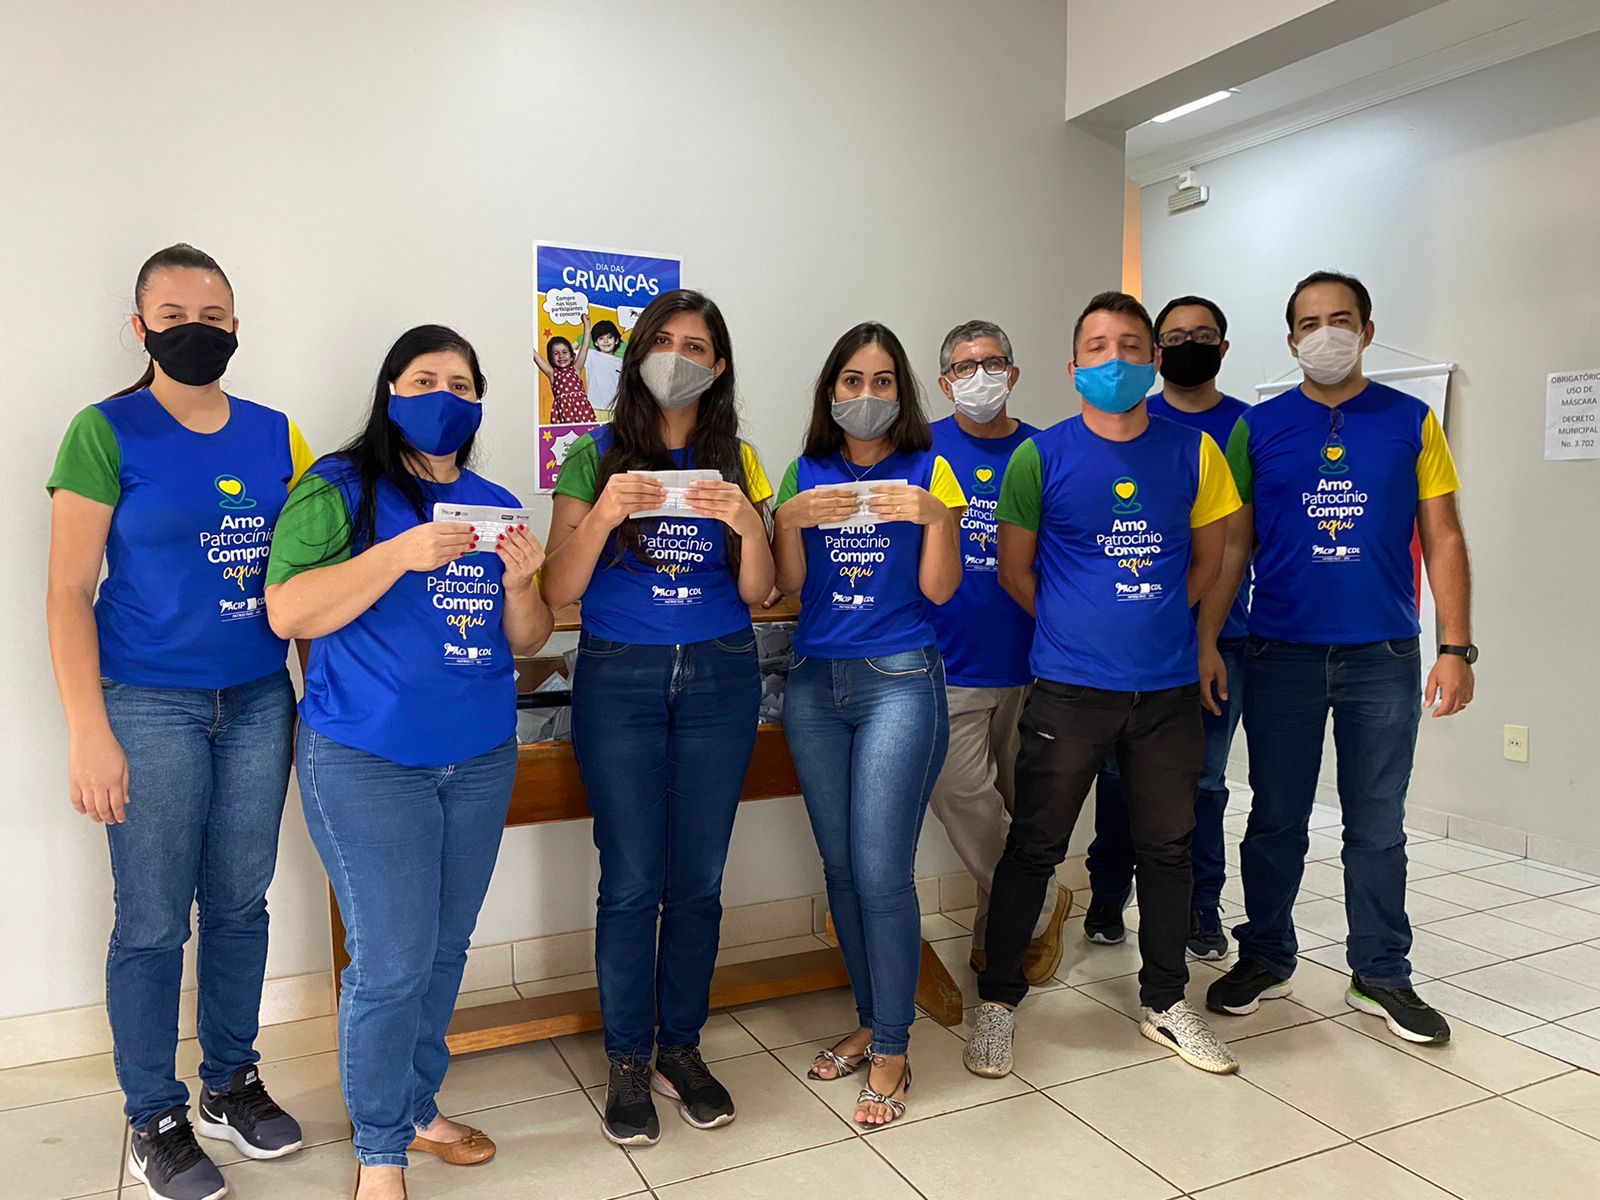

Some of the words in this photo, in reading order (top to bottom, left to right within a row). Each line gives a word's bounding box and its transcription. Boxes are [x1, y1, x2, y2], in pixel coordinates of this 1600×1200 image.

[596, 263, 608, 272] DIA
[610, 265, 625, 273] DAS
[562, 266, 659, 297] CRIANÇAS
[1566, 386, 1582, 394] USO
[1561, 397, 1597, 406] MÁSCARA
[1562, 414, 1595, 423] DECRETO
[1558, 426, 1598, 435] MUNICIPAL
[1575, 439, 1595, 448] 3.702
[1316, 479, 1352, 492] Amo
[970, 496, 998, 510] Amo
[1302, 490, 1368, 505] Patrocínio
[1307, 505, 1364, 519] Compro
[221, 515, 265, 530] Amo
[657, 521, 698, 536] Amo
[960, 518, 998, 534] Compr
[1112, 519, 1147, 533] Amo
[1318, 518, 1355, 541] aqui
[637, 534, 713, 551] Patrocínio
[825, 534, 890, 548] Patrocínio
[1096, 531, 1162, 546] Patrocínio
[208, 546, 270, 563] Compro
[645, 548, 704, 563] Compro
[830, 549, 885, 565] Compro
[1104, 545, 1161, 557] Compro
[446, 561, 484, 577] Amo
[1118, 556, 1153, 577] aqui
[223, 562, 262, 591] aqui
[840, 565, 873, 588] aqui
[427, 576, 499, 595] Patrocínio
[433, 594, 493, 614] Compro
[447, 614, 485, 640] aqui
